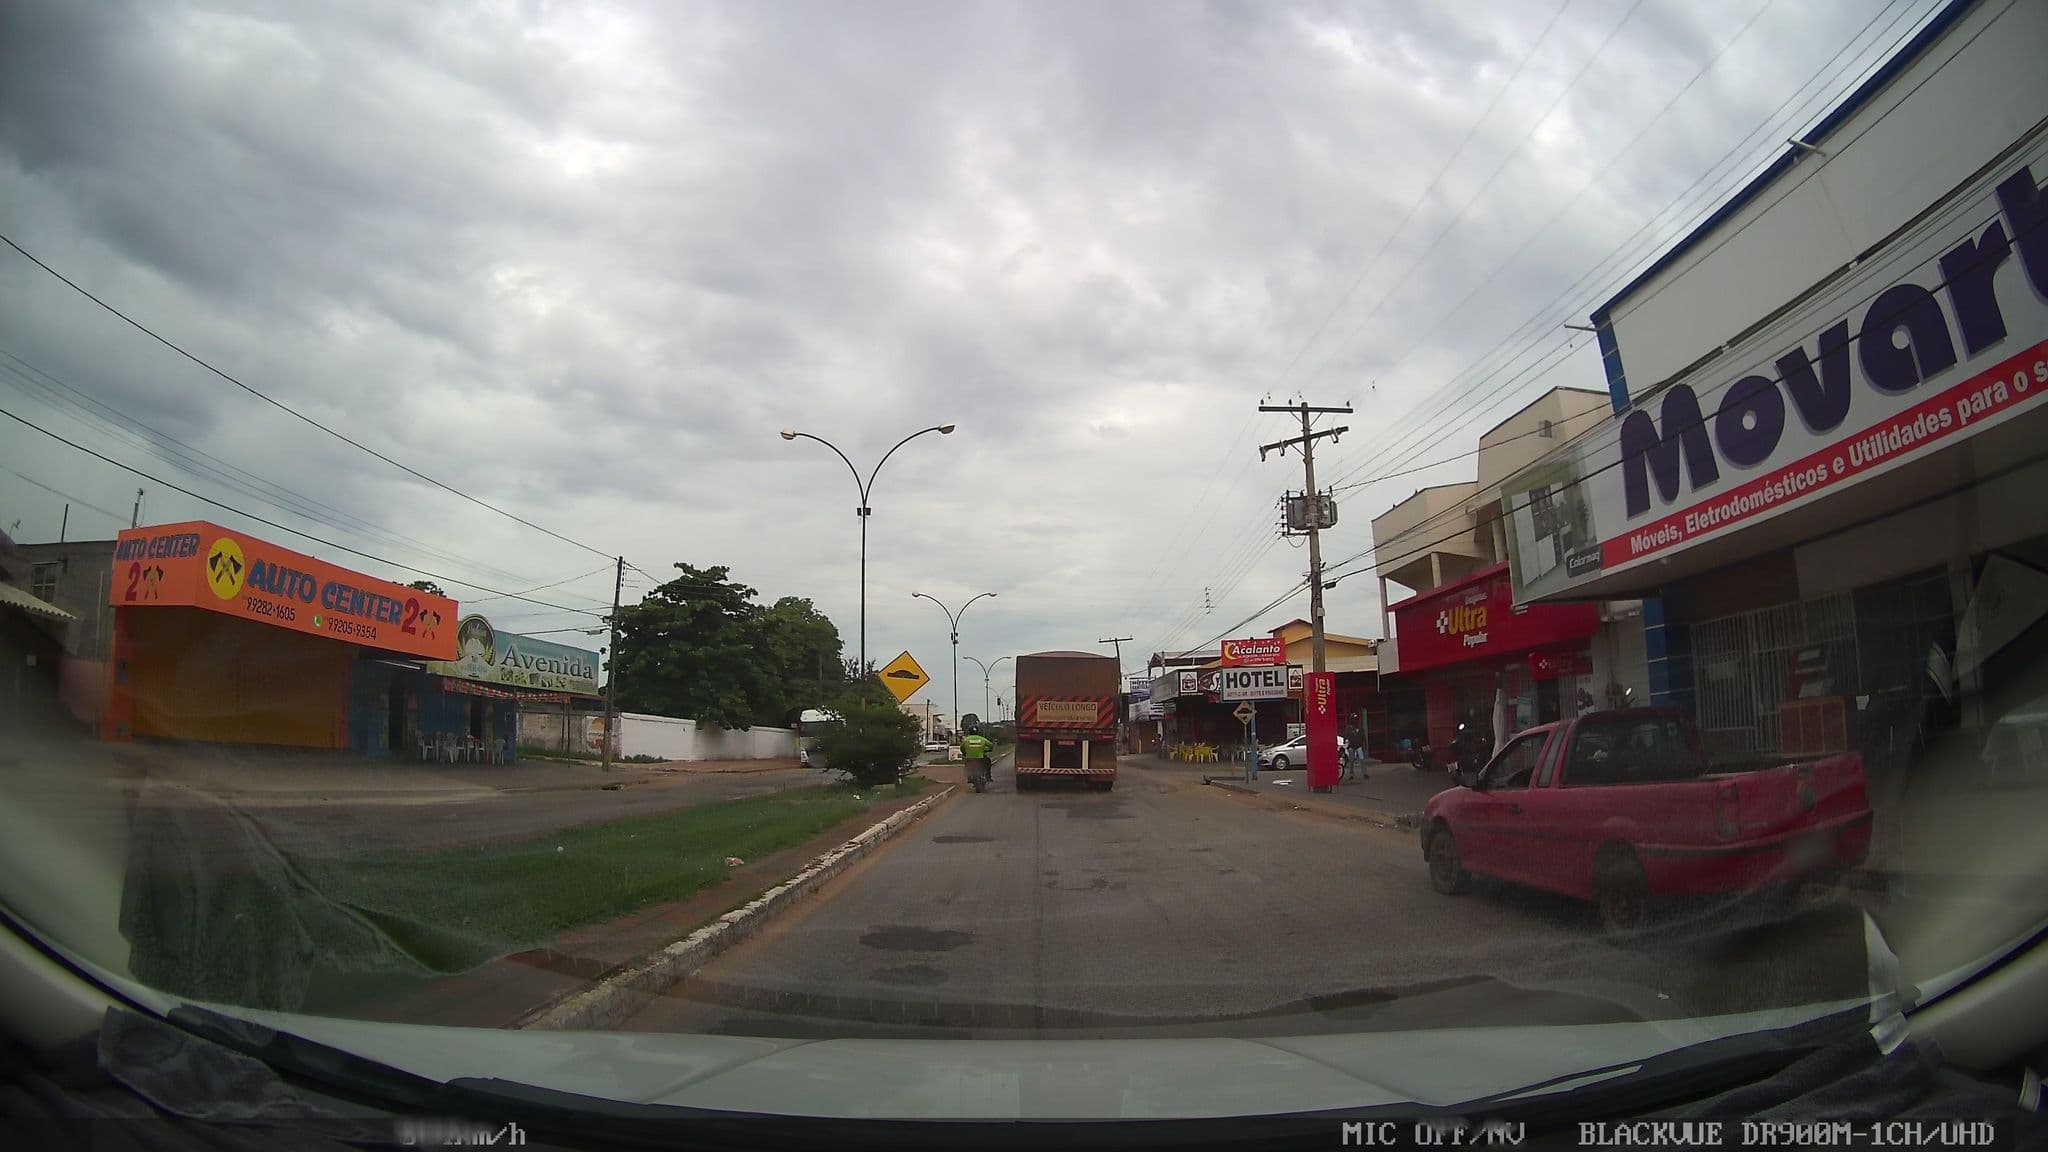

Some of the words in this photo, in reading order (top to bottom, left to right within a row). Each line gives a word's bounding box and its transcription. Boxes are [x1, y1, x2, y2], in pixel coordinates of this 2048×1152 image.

[1631, 524, 1683, 554] Móveis,
[1686, 463, 1828, 534] Eletrodomésticos
[1833, 456, 1844, 474] e
[1849, 407, 1952, 467] Utilidades
[1957, 380, 2009, 426] para
[2013, 371, 2028, 393] o
[148, 533, 200, 559] CENTER
[125, 562, 141, 602] 2
[247, 558, 317, 604] AUTO
[322, 581, 404, 625] CENTER
[401, 597, 420, 636] 2
[1448, 605, 1488, 635] Ultra
[501, 643, 594, 680] Avenida
[1232, 644, 1281, 655] Acalanto
[1225, 670, 1285, 689] HOTEL
